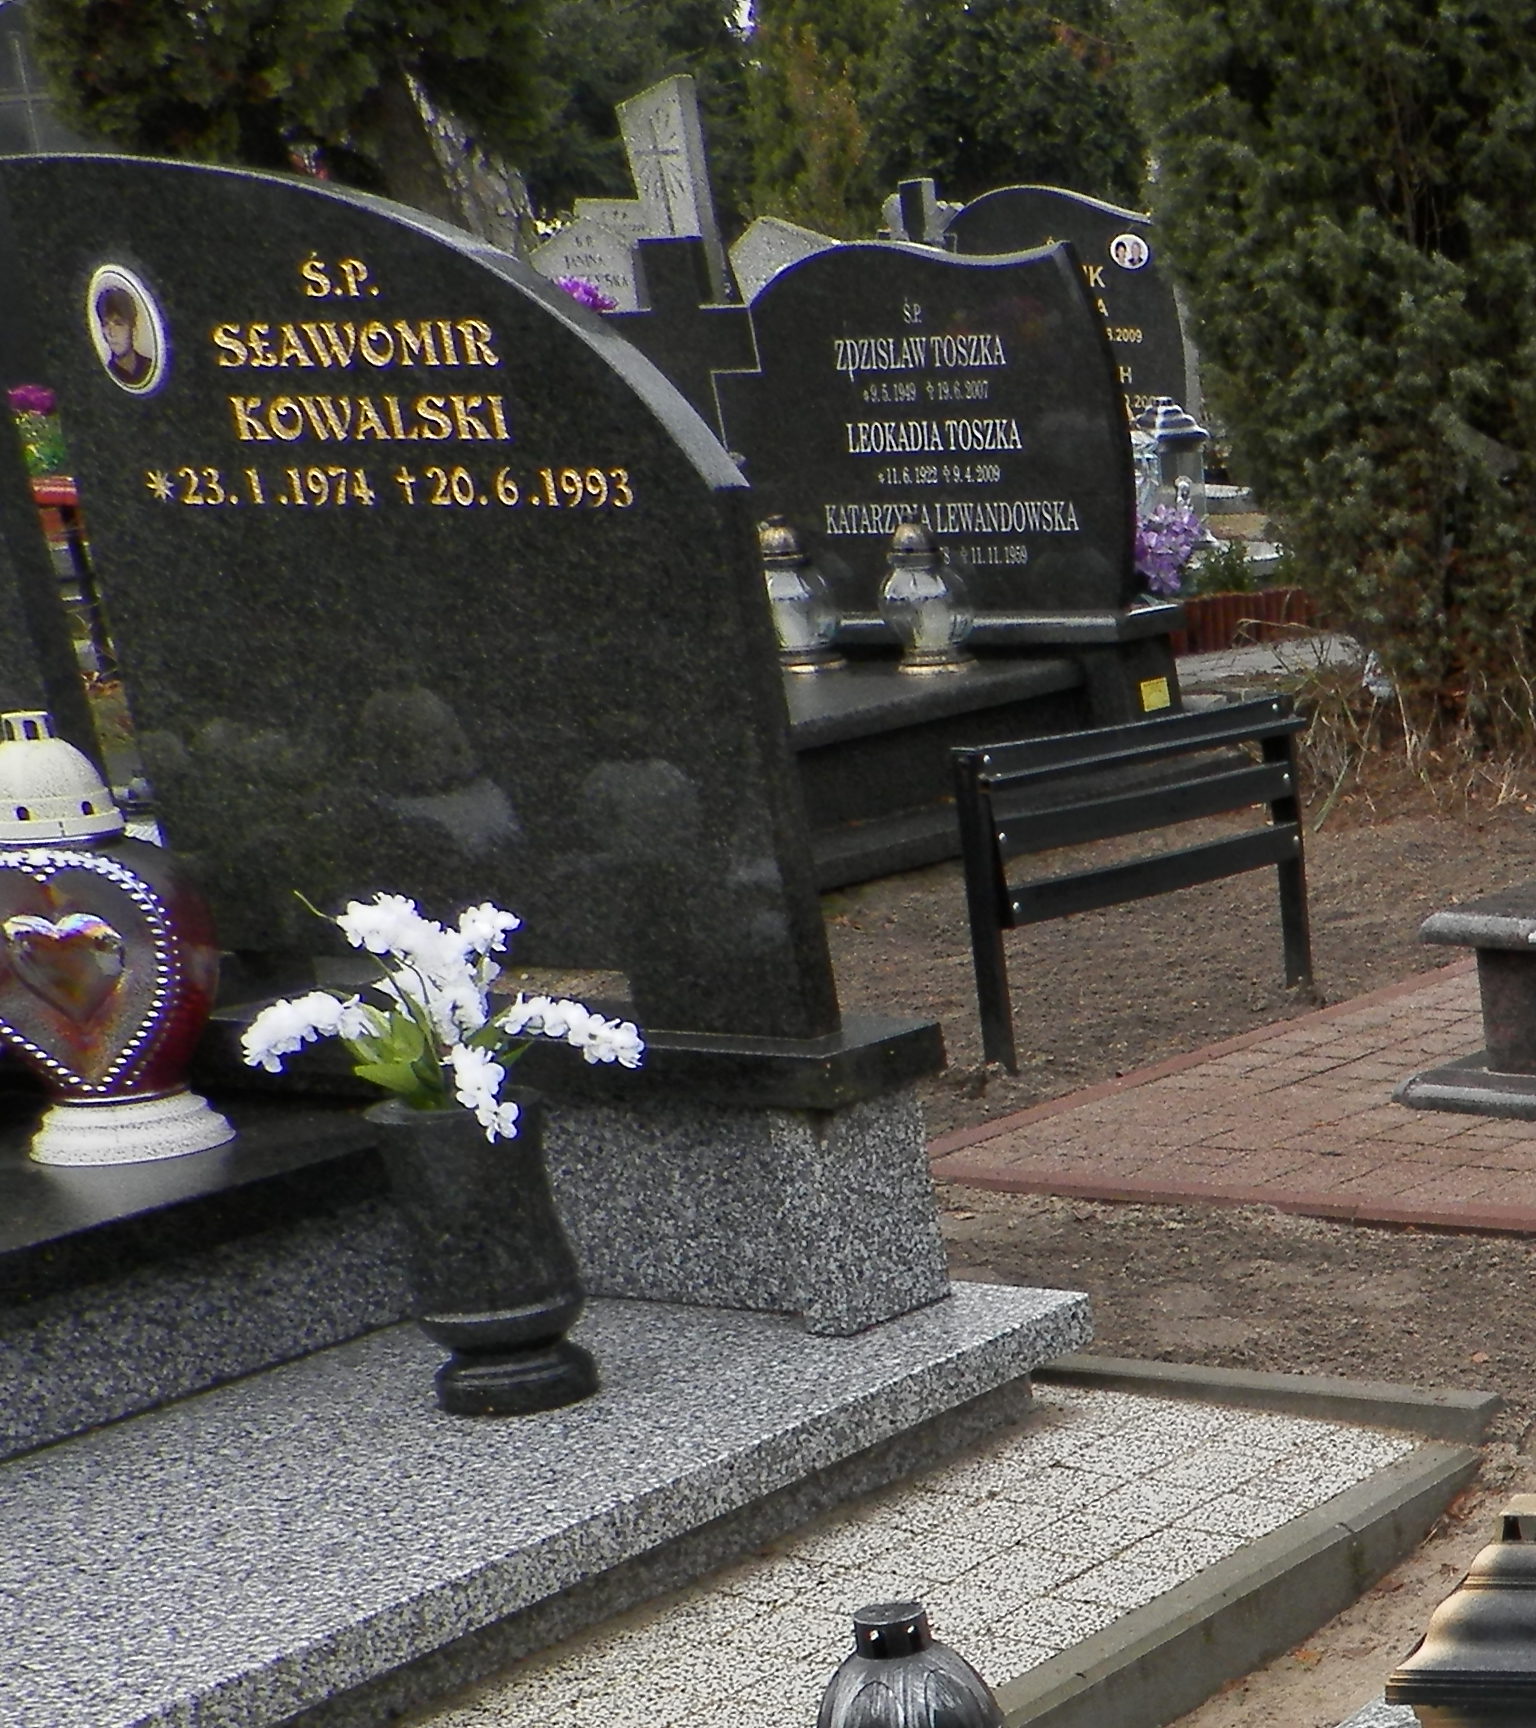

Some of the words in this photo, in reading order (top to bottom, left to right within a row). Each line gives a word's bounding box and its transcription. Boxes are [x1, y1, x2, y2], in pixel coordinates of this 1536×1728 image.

[302, 251, 380, 298] Ś.P.
[211, 318, 500, 368] SŁAWOMIR
[930, 334, 1008, 367] TOSZKA
[230, 394, 512, 442] KOWALSKI
[846, 420, 944, 454] LEOKADIA
[945, 418, 1023, 451] TOSZKA
[935, 500, 1080, 533] LEWANDOWSKA
